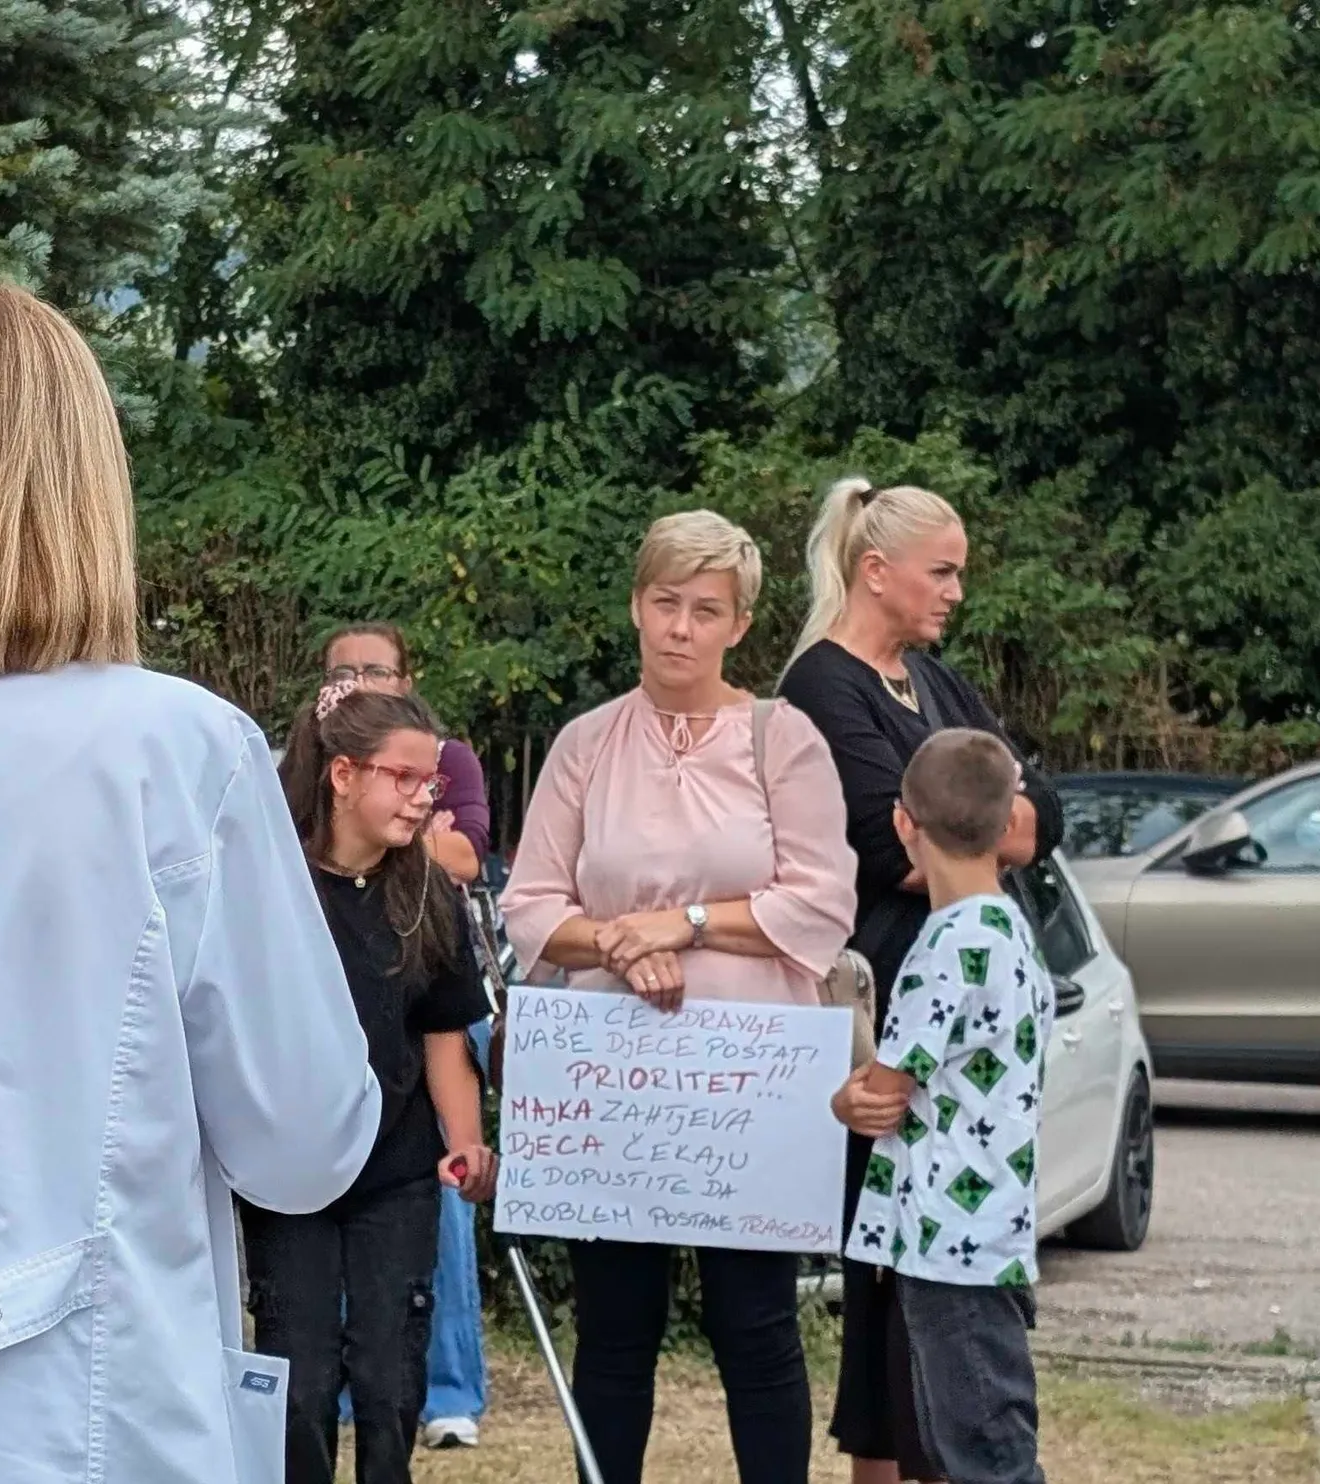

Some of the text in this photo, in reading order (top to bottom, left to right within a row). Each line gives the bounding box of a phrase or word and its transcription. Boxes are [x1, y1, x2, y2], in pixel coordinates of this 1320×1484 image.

[516, 995, 593, 1025] KADA
[604, 996, 651, 1029] ĆE
[514, 1024, 820, 1064] NAŠE DJECE POSTATI
[511, 1096, 754, 1136] MAJKA ZAHTJEVA
[506, 1131, 749, 1177] DJECA ČEKAJU
[504, 1166, 738, 1199] NE DOPUSTITE DA
[503, 1200, 633, 1227] PROBLEM
[648, 1205, 732, 1232] POSTANE
